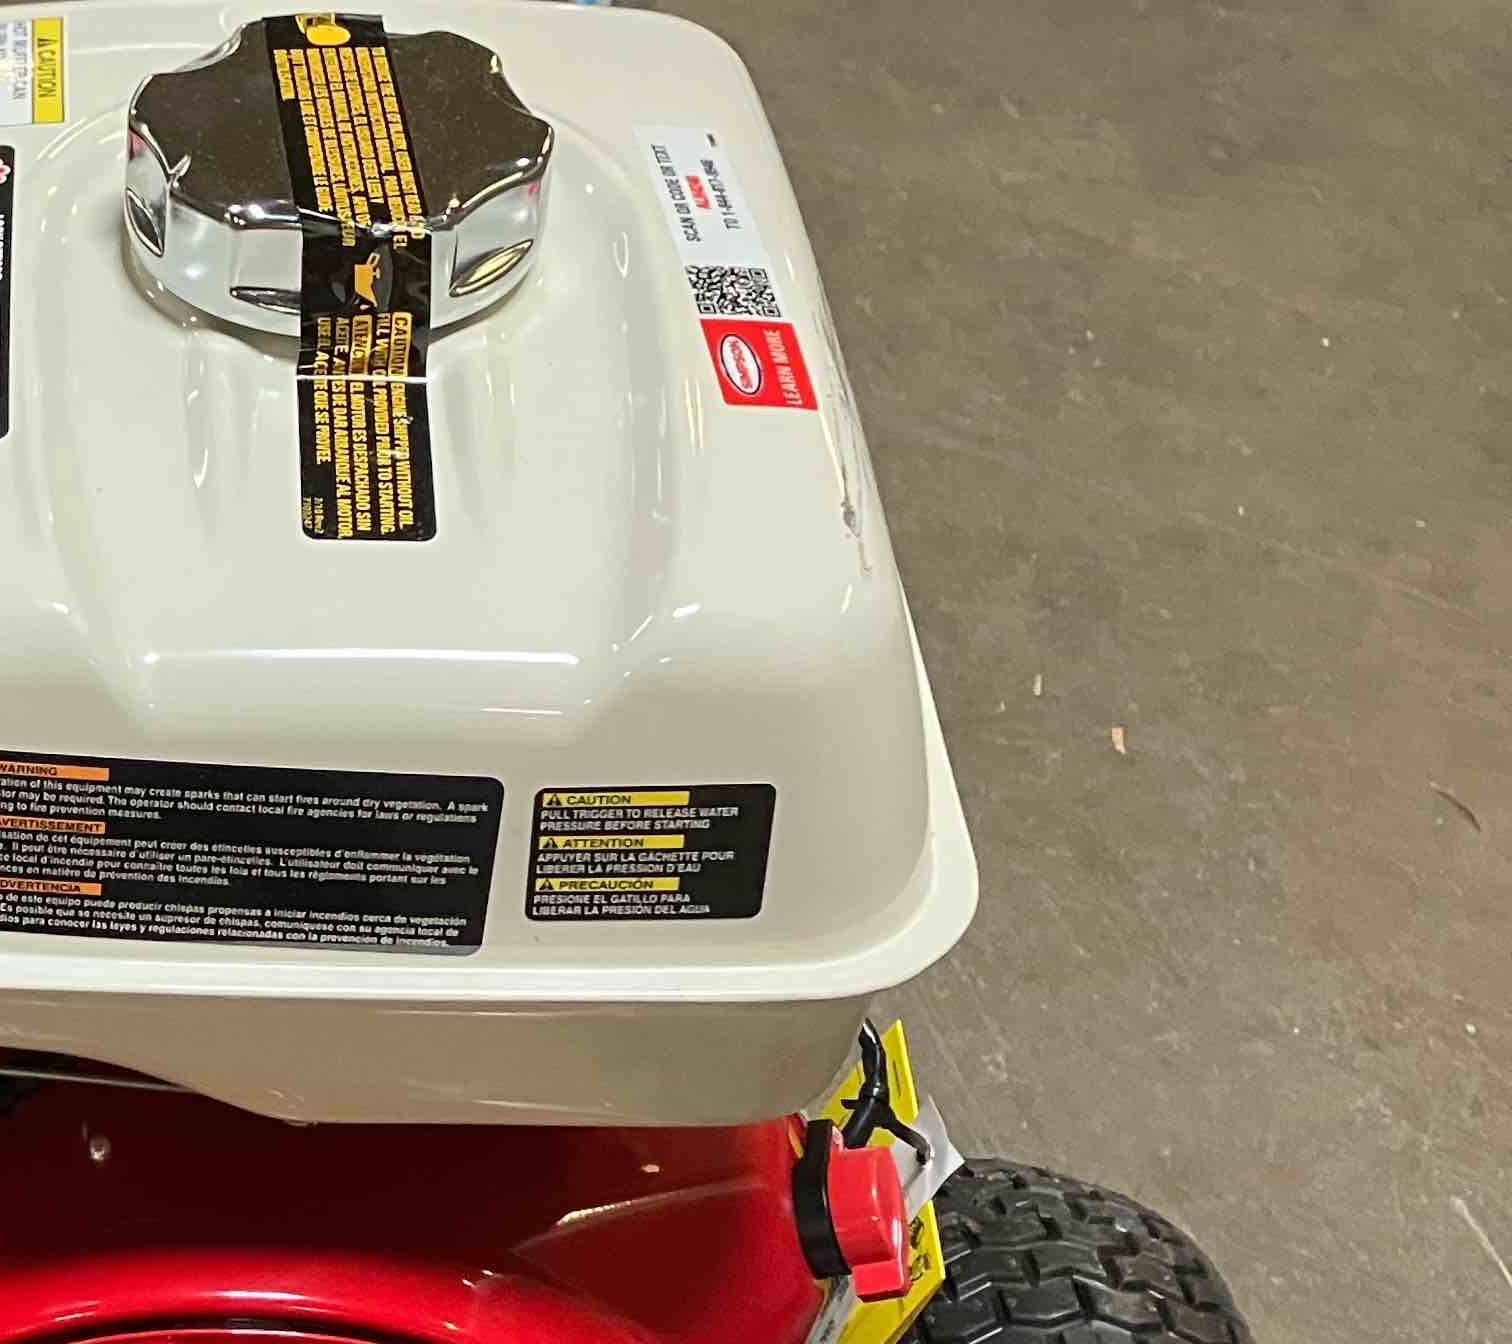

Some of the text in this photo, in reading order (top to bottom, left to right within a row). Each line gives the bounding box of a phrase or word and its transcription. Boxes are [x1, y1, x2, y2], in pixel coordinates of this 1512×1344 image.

[38, 49, 57, 98] CAUTION
[764, 329, 804, 405] LEARN MORE
[351, 394, 366, 428] MOTOR
[353, 430, 367, 442] ES
[335, 429, 351, 484] ARRANQUE
[353, 443, 369, 509] DESPACHADO
[378, 467, 392, 479] TO
[336, 484, 351, 498] AL
[397, 461, 412, 508] WITHOUT
[379, 482, 395, 534] STARTING.
[337, 499, 353, 539] MOTOR.
[356, 511, 371, 531] SIN
[399, 510, 413, 528] OIL.
[43, 779, 62, 789] this
[66, 781, 121, 795] equipment
[149, 786, 180, 796] create
[184, 788, 219, 801] sparks
[223, 791, 243, 800] that
[268, 793, 293, 802] start
[296, 794, 318, 804] fires
[322, 795, 359, 806] around
[566, 794, 632, 805] CAUTION
[30, 803, 46, 811] fire
[49, 804, 105, 817] prevention
[108, 810, 162, 819] measures.
[59, 793, 104, 805] required.
[129, 797, 174, 810] operator
[177, 800, 213, 810] should
[216, 802, 255, 812] contact
[258, 804, 284, 814] local
[286, 806, 303, 815] fire
[306, 807, 354, 819] agencies
[540, 806, 739, 819] PULL TRIGGER TO RELEASE WATER
[540, 819, 711, 831] PRESSURE BEFORE STARTING
[563, 837, 644, 848] ATTENTION
[12, 853, 121, 870] local pour
[537, 852, 591, 863] APPUYER
[593, 852, 618, 862] SUR
[620, 852, 637, 862] LA
[701, 850, 734, 861] POUR
[587, 864, 603, 874] LA
[605, 863, 664, 874] PRESSION
[666, 863, 702, 873] D'EAU
[45, 895, 80, 907] equipo
[118, 899, 162, 912] producir
[533, 893, 691, 904] PRESIONE EL GATILLO PARA
[532, 905, 582, 916] LIBERAR
[584, 905, 600, 915] LA
[654, 905, 677, 915] DEL
[679, 904, 710, 914] AGUA
[47, 918, 214, 937] conocer regulaciones
[418, 927, 442, 936] local
